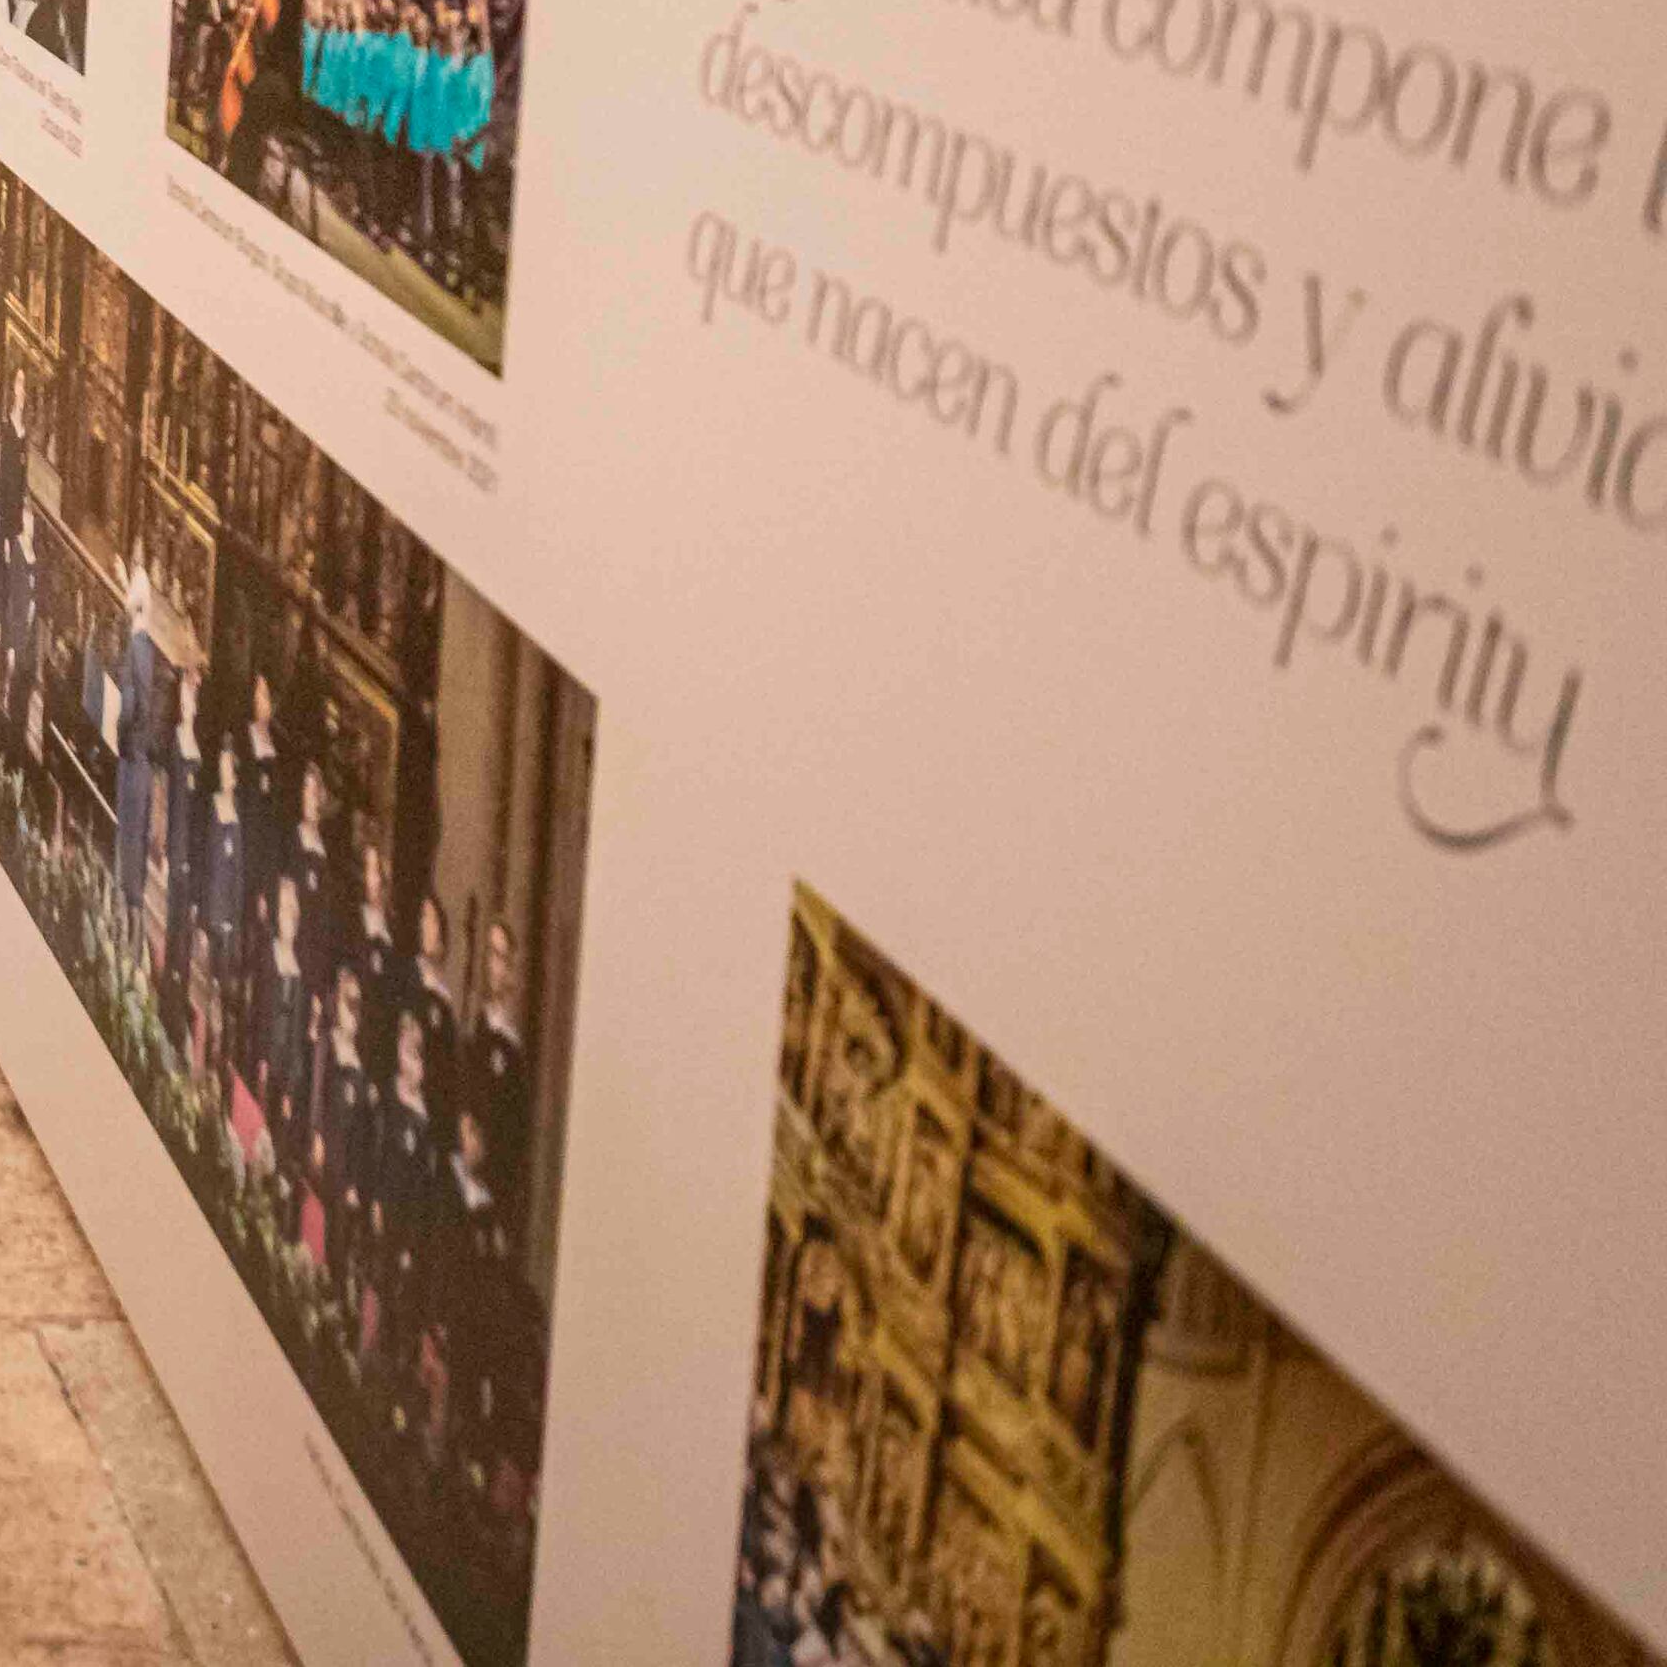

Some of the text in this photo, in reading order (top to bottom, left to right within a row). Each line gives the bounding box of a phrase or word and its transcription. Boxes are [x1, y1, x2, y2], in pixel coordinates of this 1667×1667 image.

[686, 208, 798, 326] que
[805, 267, 1019, 455] nacen
[1032, 369, 1194, 538] del
[700, 0, 1267, 344] descompuestos
[1261, 271, 1373, 416] y
